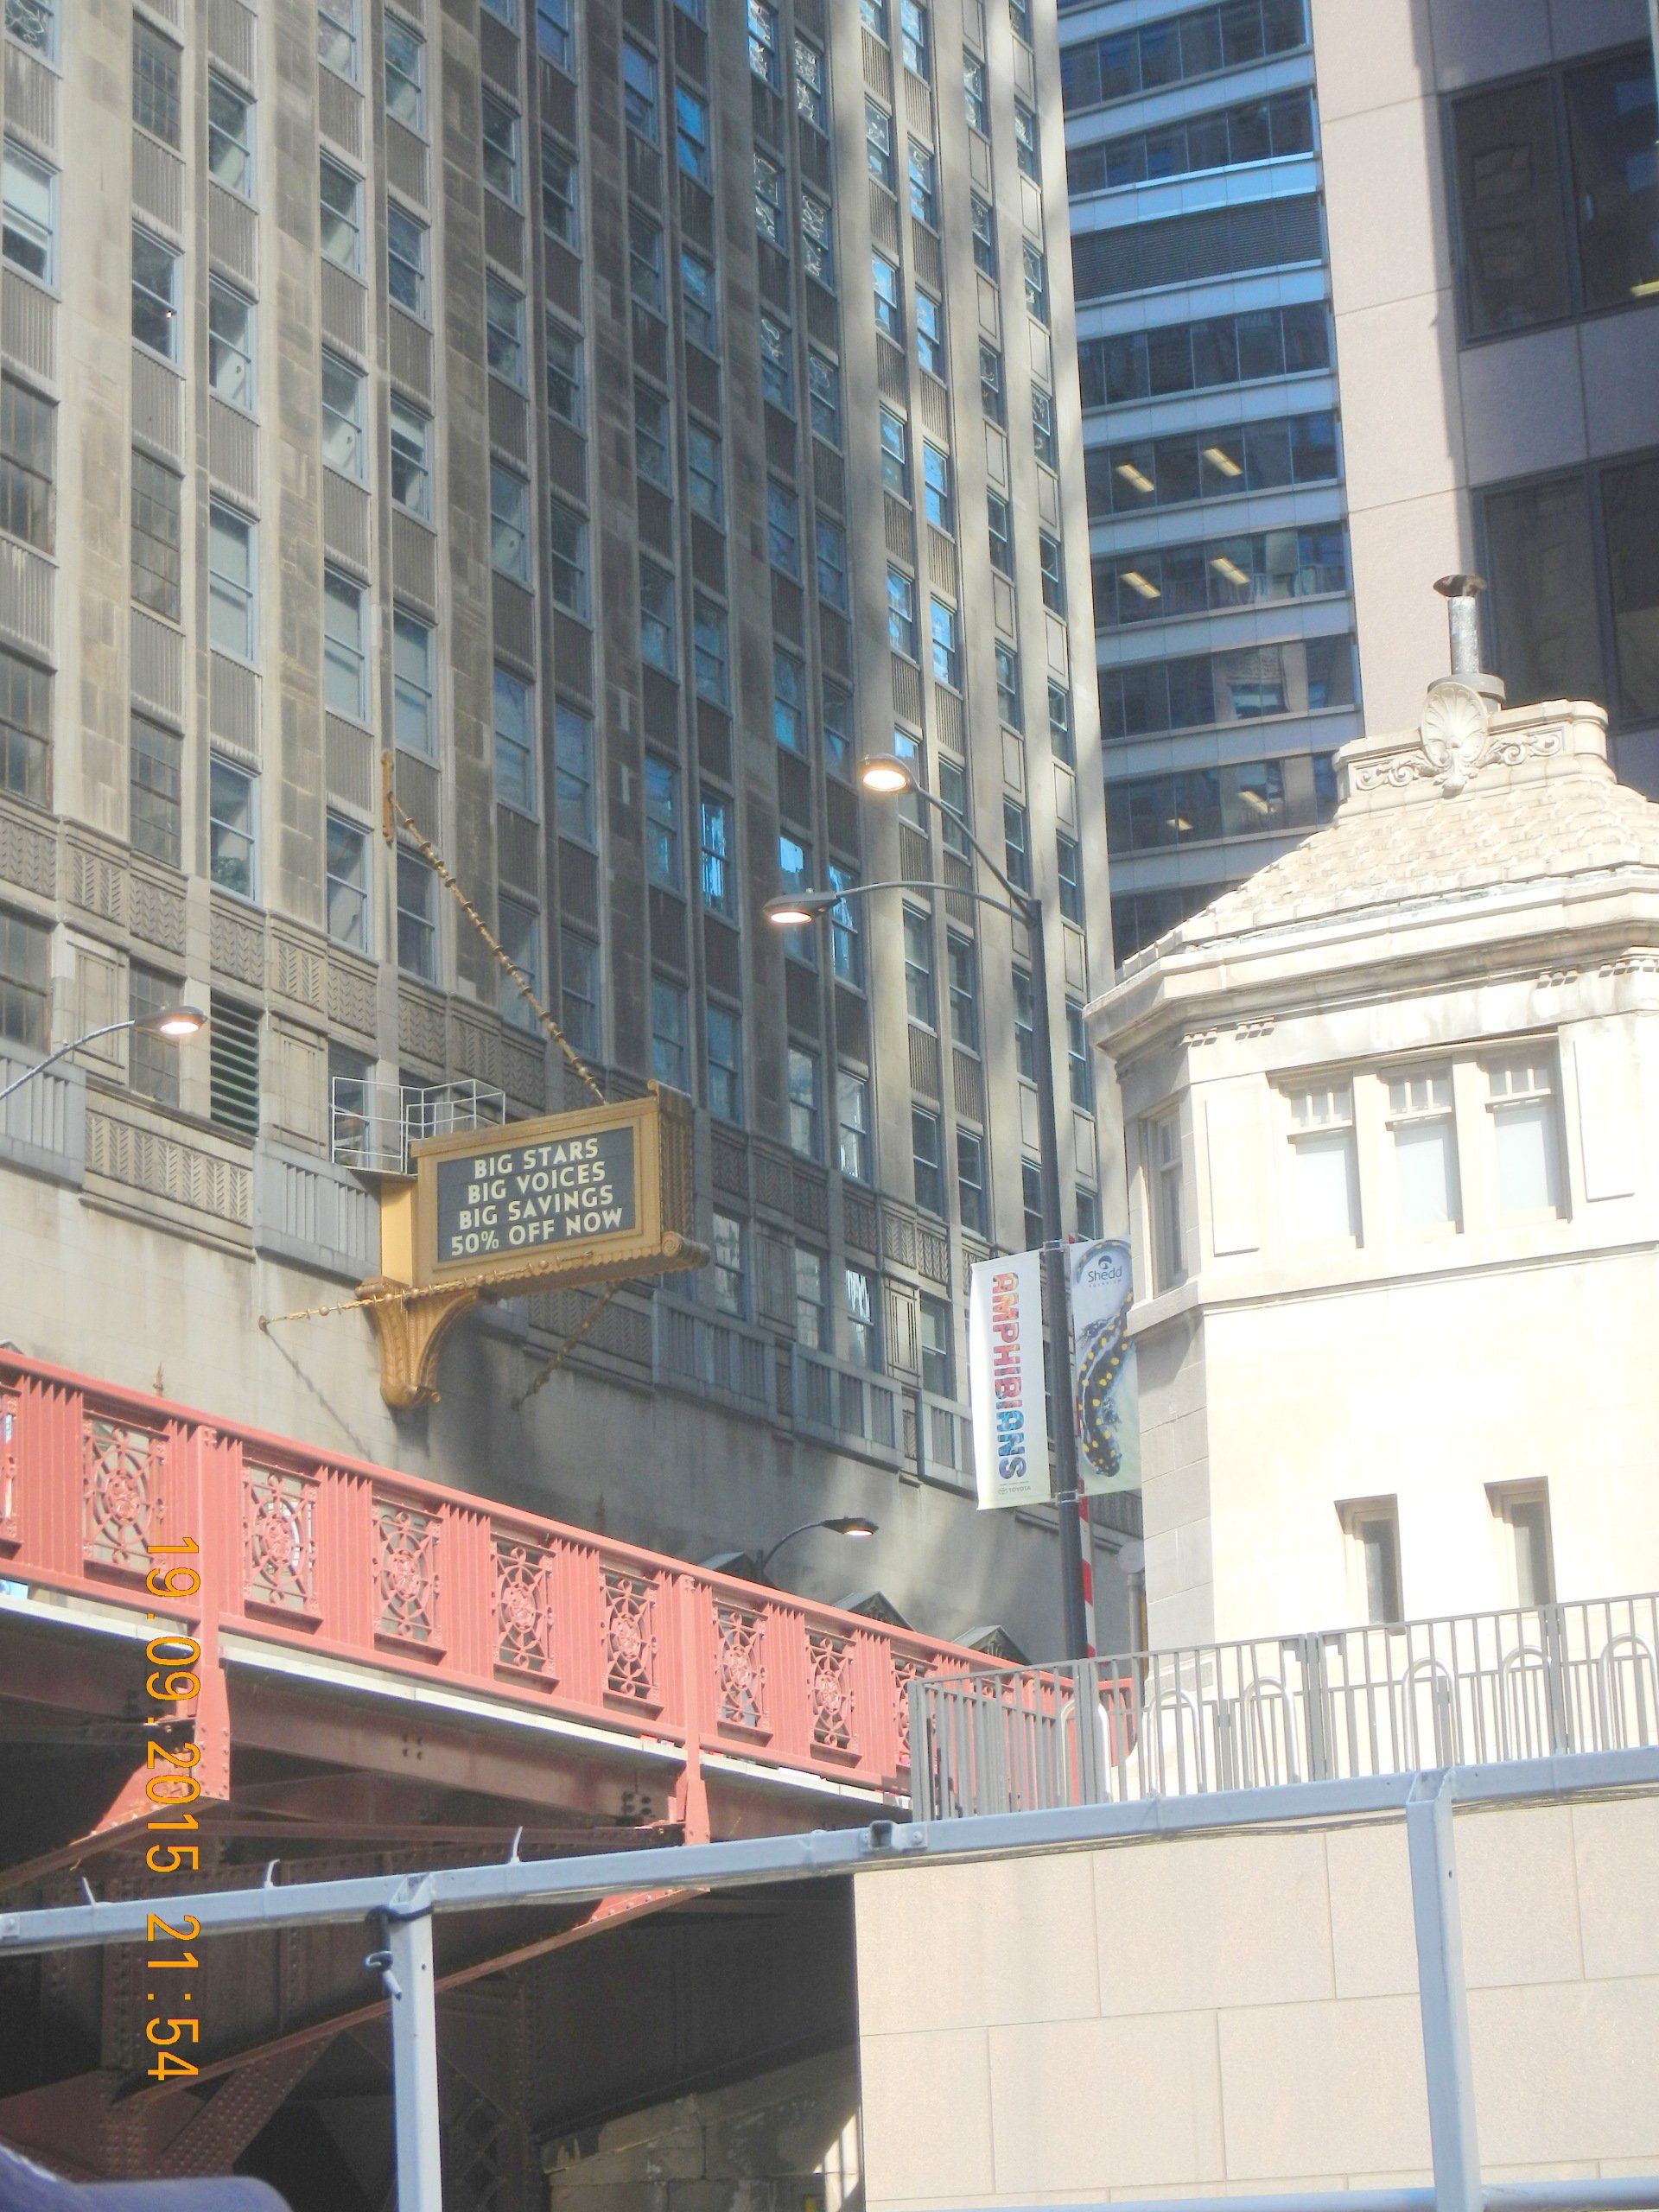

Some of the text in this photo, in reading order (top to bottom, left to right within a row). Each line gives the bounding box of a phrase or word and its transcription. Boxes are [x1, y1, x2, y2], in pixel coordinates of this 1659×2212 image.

[474, 1137, 599, 1179] BIG STARS
[467, 1160, 606, 1205] BIG VOICES
[459, 1184, 613, 1230] BIG SAVINGS
[451, 1207, 623, 1256] 50% OFF NOW
[1087, 1265, 1122, 1283] Shedd
[991, 1271, 1027, 1479] AMPHIBIANS
